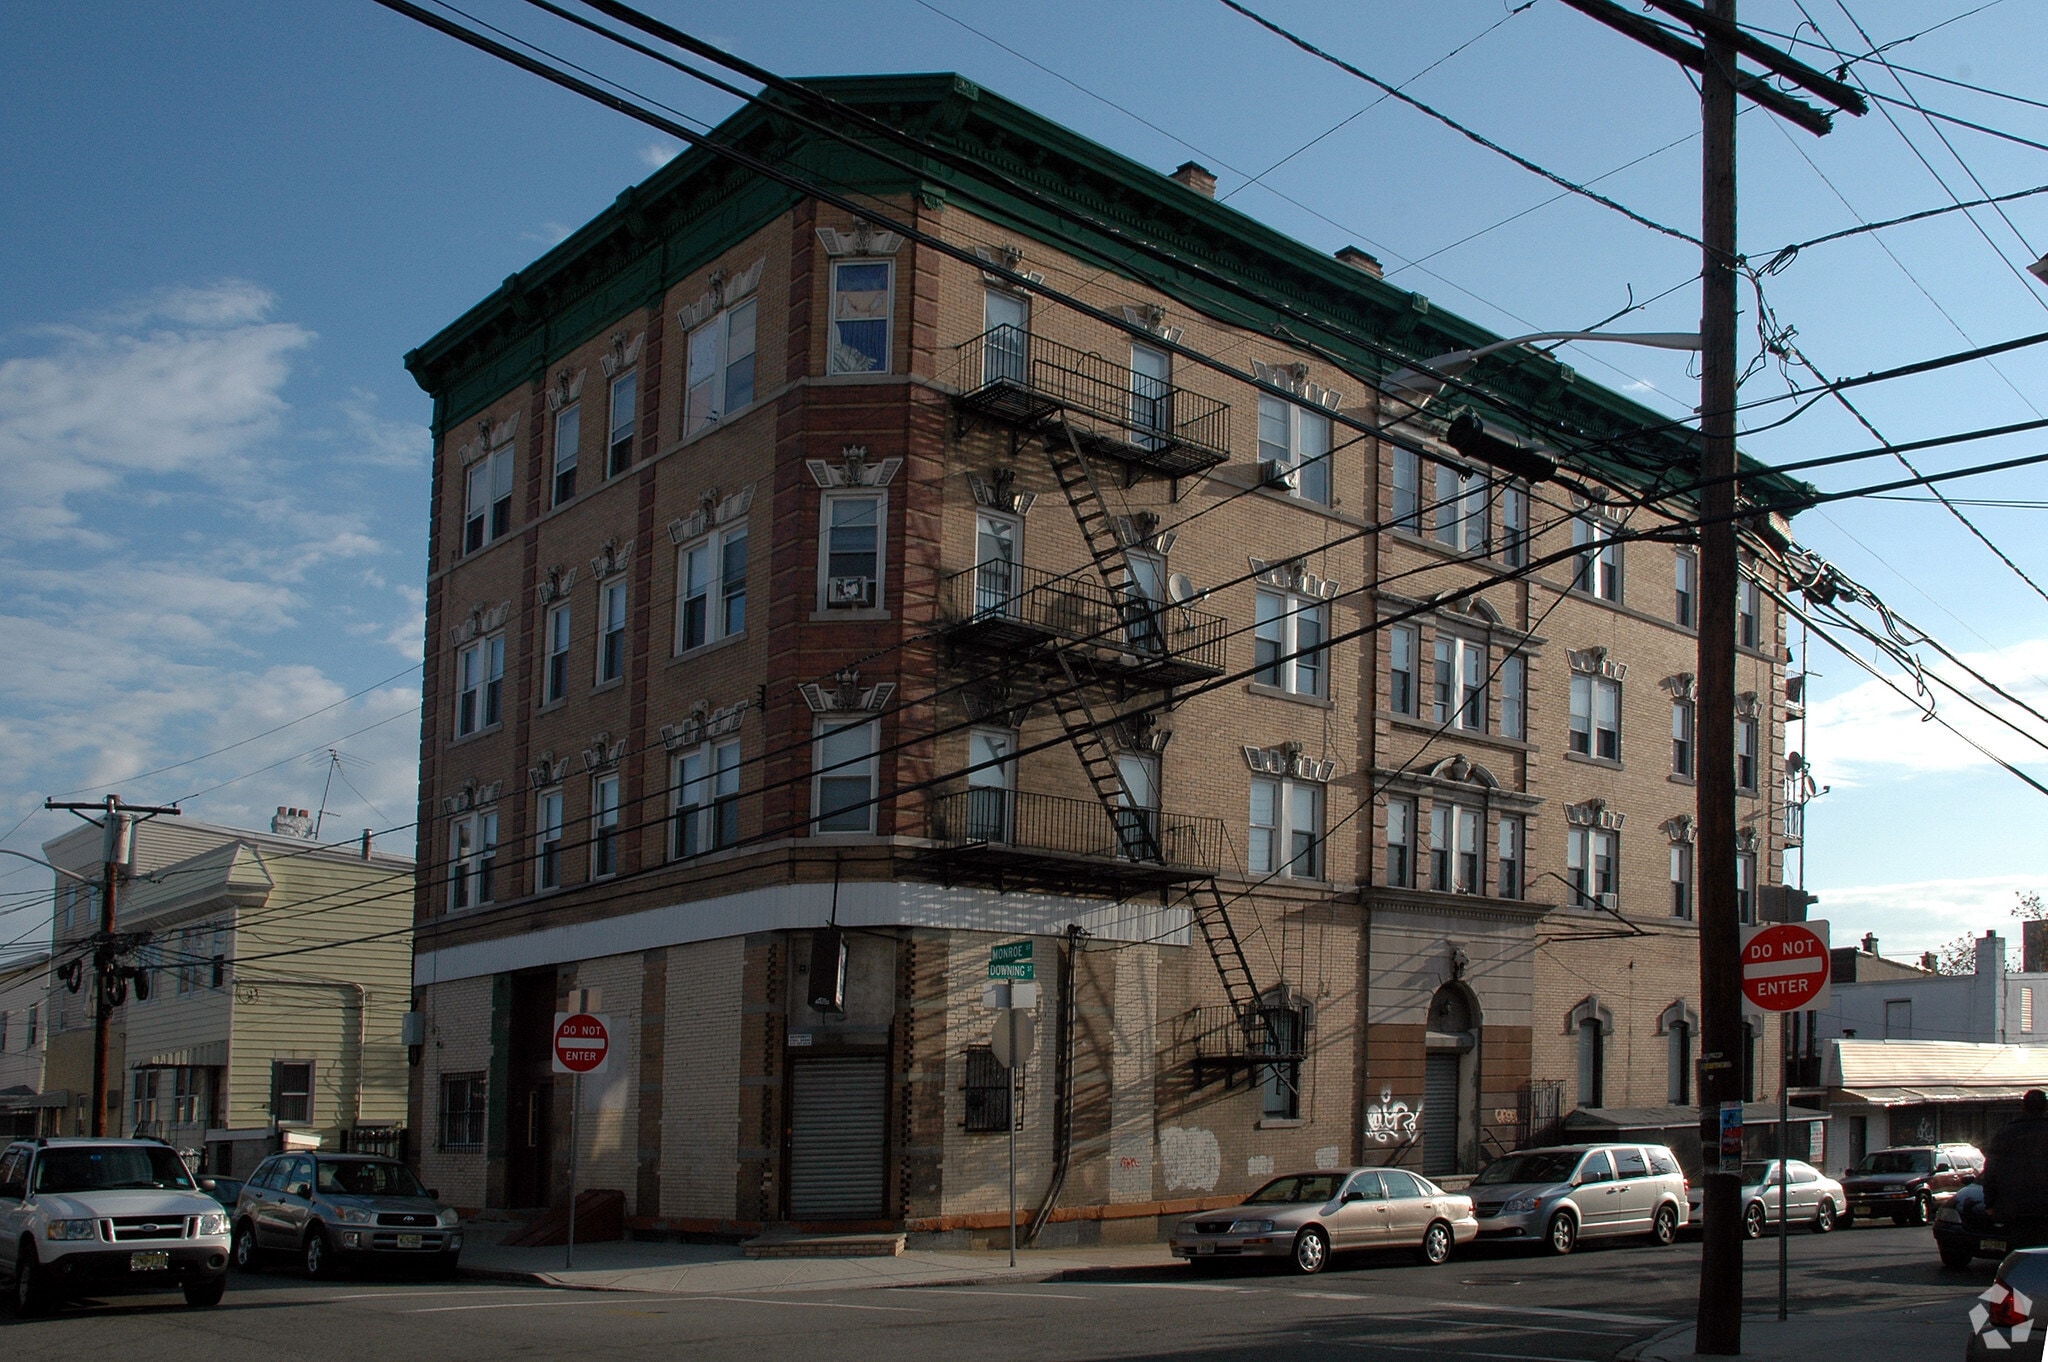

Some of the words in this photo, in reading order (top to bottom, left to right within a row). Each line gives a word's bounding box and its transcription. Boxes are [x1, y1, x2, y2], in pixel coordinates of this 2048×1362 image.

[992, 945, 1023, 960] MONROE
[1751, 944, 1772, 959] DO
[1782, 939, 1815, 955] NOT
[990, 964, 1025, 977] DOWNING
[1757, 978, 1808, 996] ENTER
[563, 1025, 577, 1035] DO
[582, 1025, 601, 1036] NOT
[566, 1051, 596, 1061] ENTER
